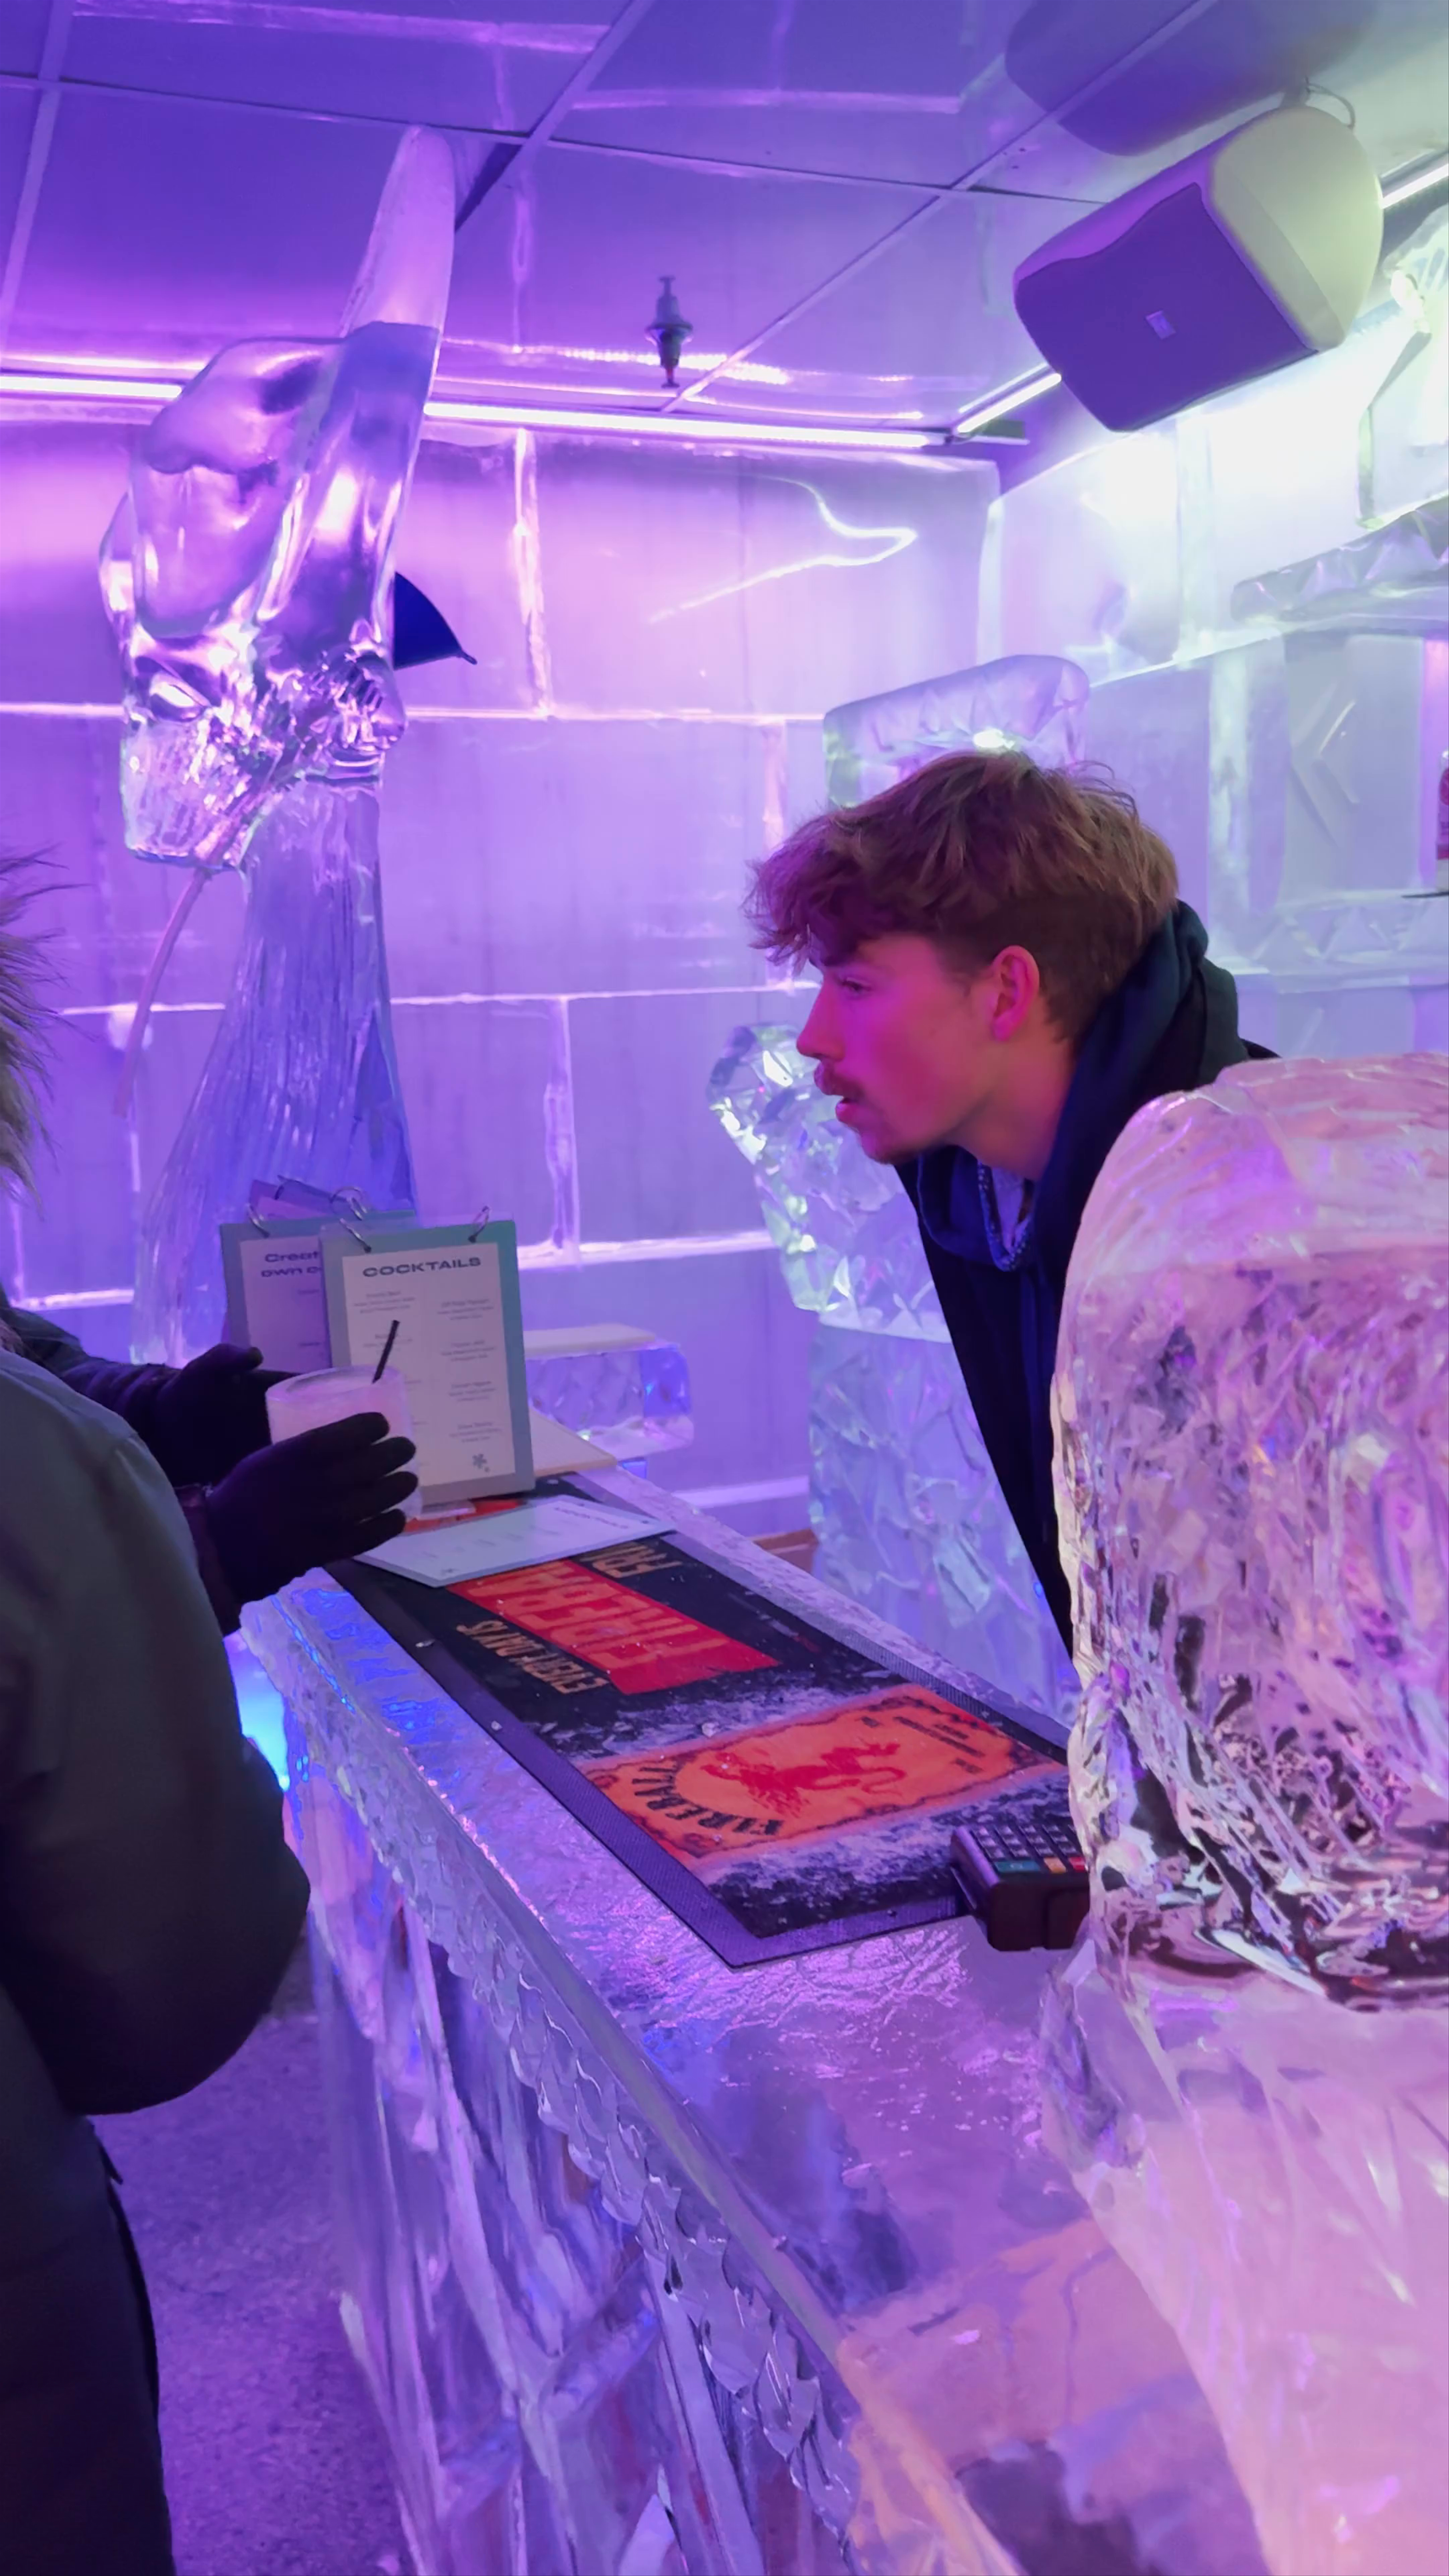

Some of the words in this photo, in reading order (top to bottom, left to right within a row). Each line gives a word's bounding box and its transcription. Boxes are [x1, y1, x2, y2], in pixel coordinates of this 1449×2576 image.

[261, 1267, 303, 1278] own
[363, 1257, 481, 1277] COCKTAILS
[632, 1766, 784, 1835] FIREBALL
